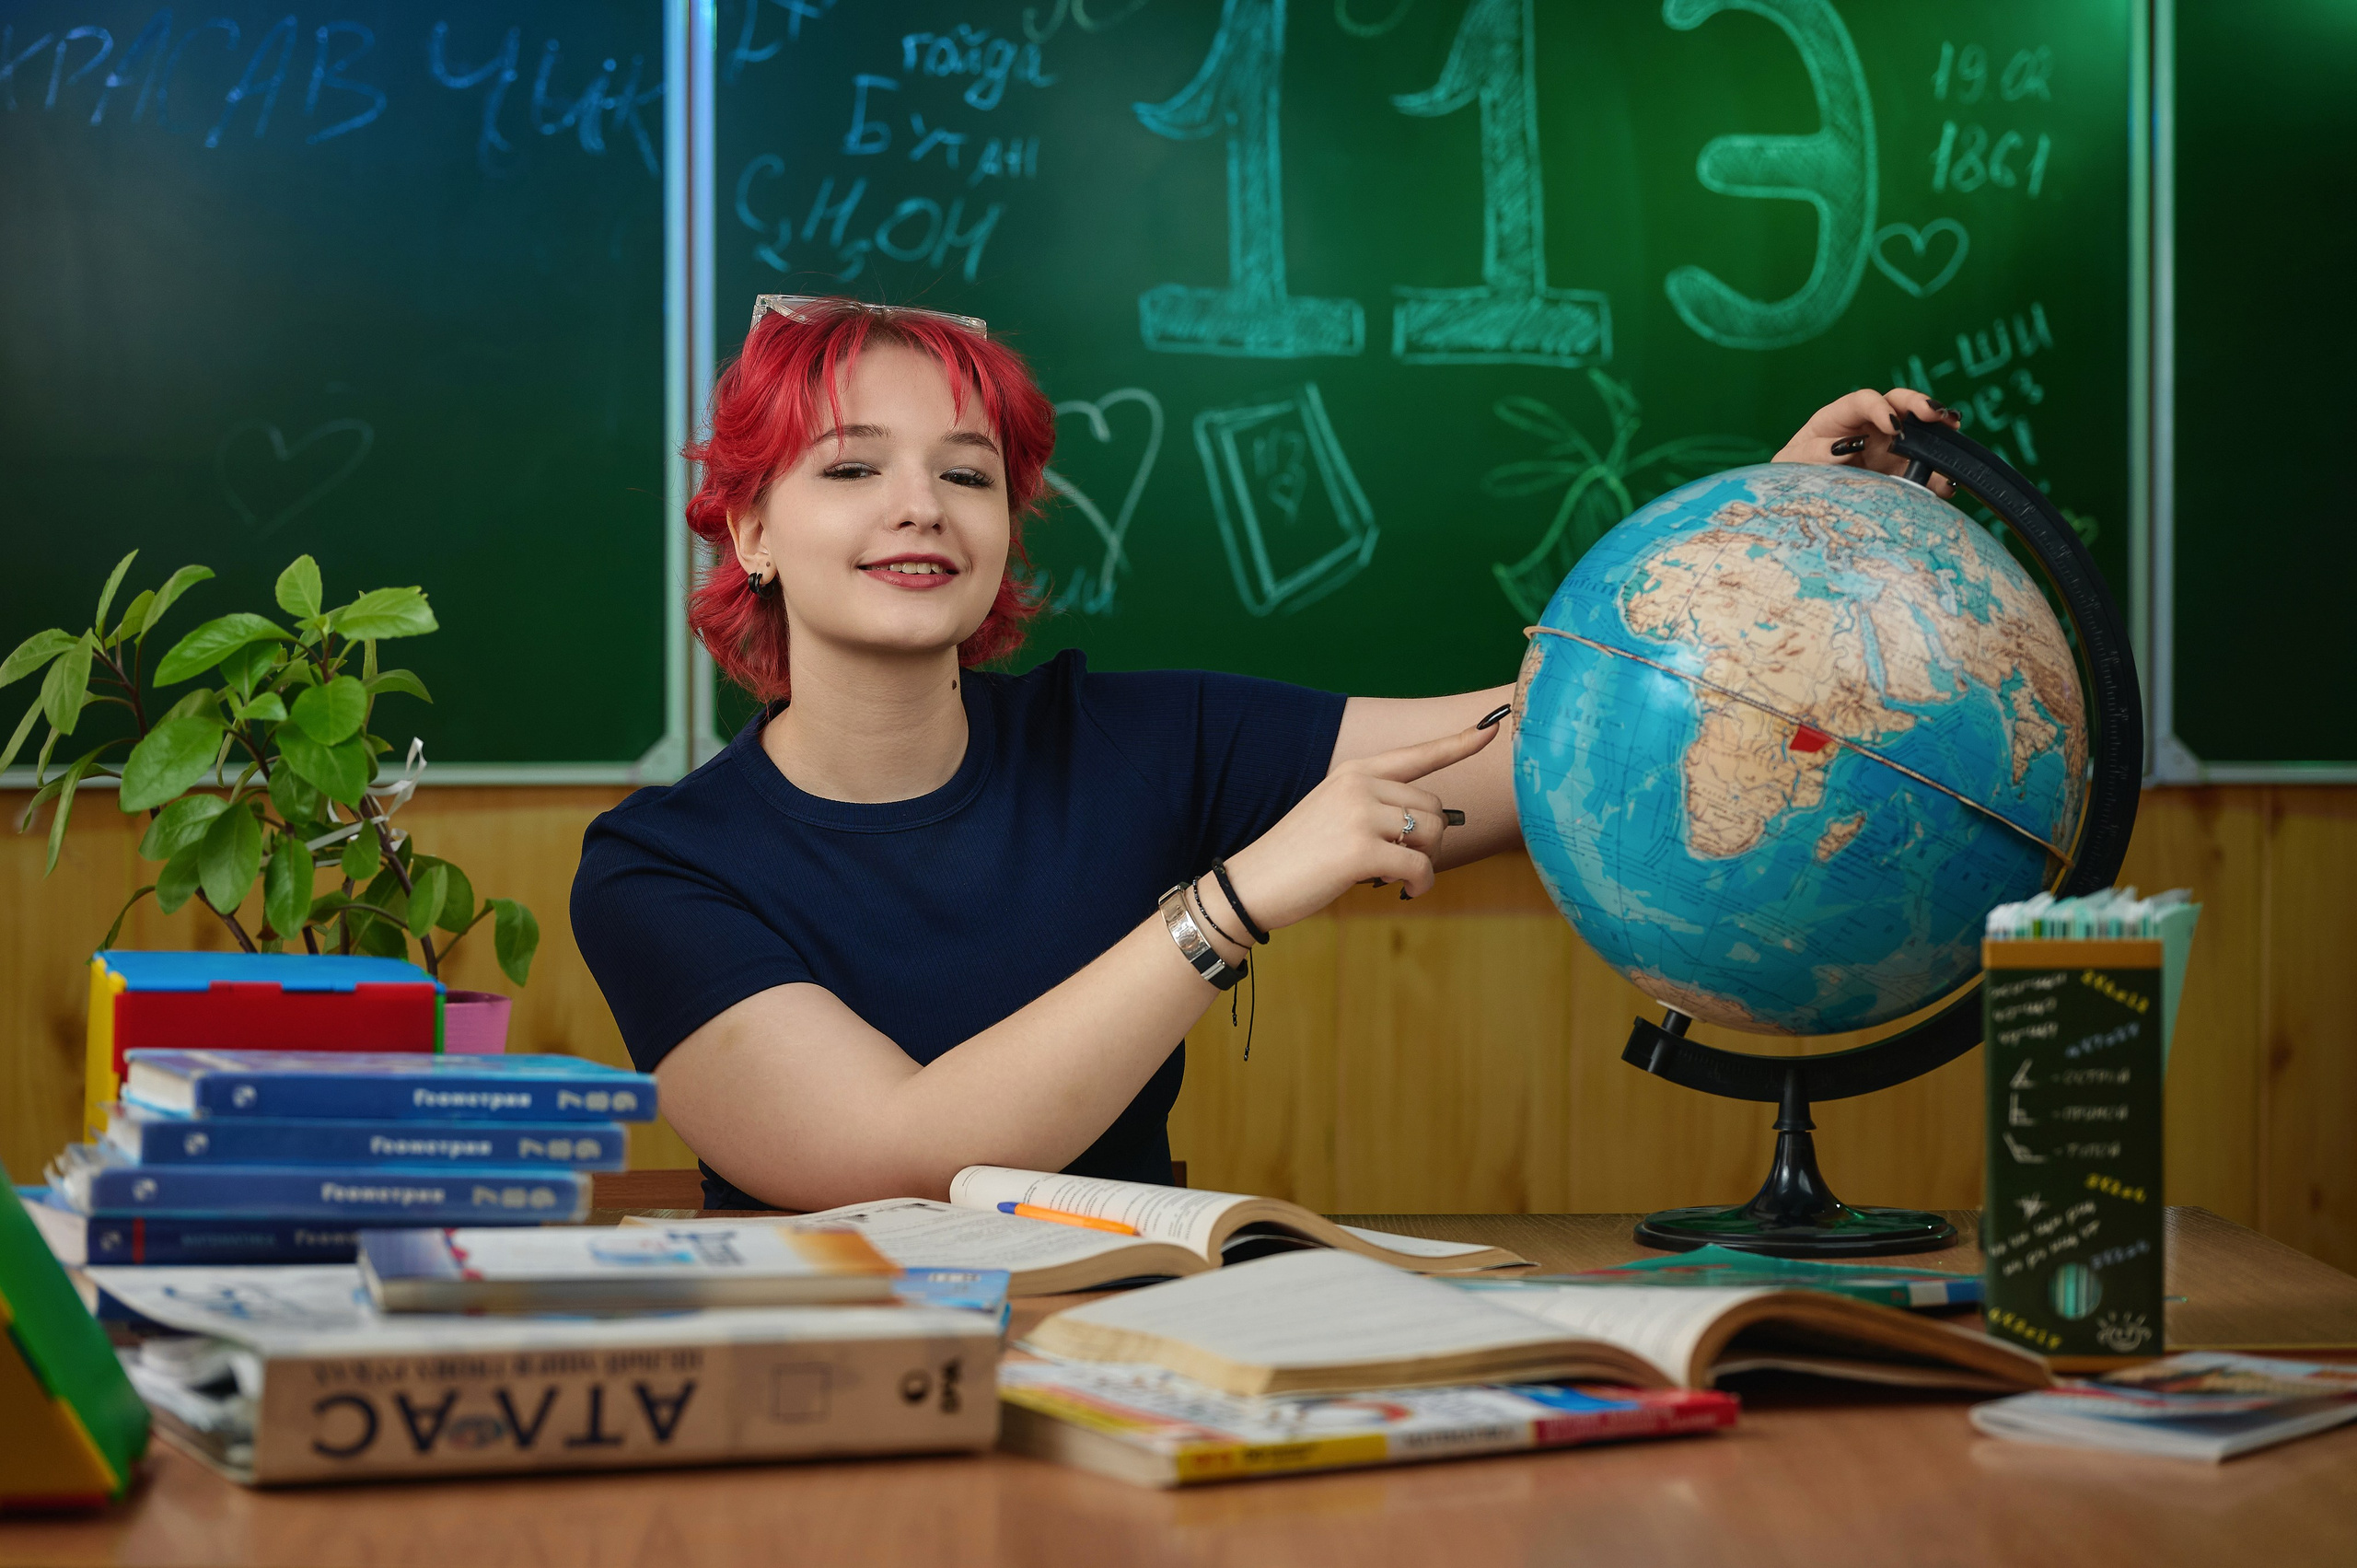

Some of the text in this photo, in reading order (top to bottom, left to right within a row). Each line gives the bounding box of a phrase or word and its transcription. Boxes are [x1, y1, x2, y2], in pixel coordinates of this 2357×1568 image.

[1930, 121, 2051, 199] 1861
[412, 1087, 533, 1110] Геометрия
[369, 1135, 493, 1158] Геометрия
[320, 1182, 446, 1205] Геометрия
